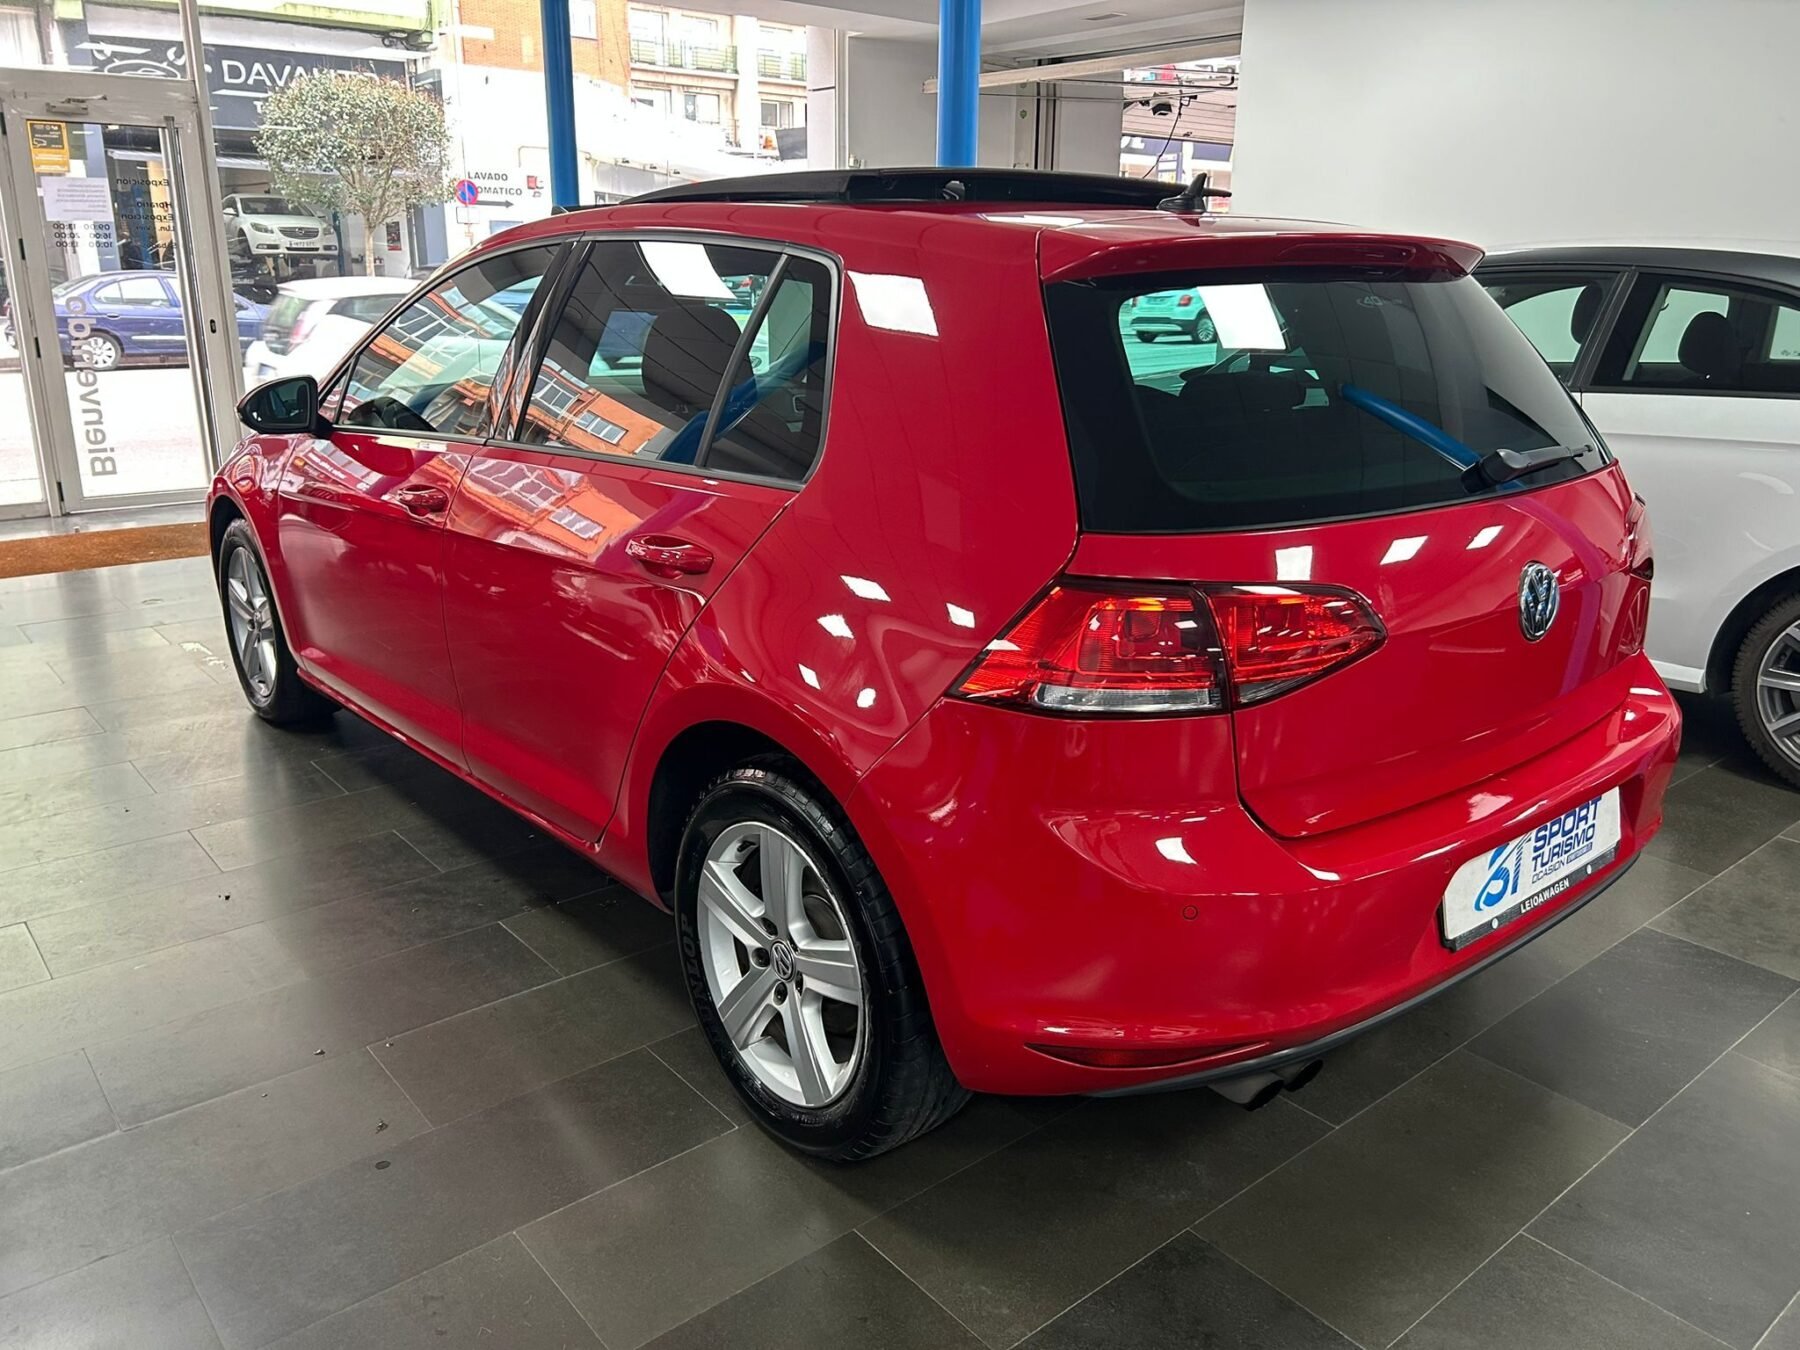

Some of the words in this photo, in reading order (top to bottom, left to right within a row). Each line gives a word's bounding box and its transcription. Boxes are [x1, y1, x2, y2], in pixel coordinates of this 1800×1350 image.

[467, 172, 508, 181] LAVADO
[477, 186, 523, 196] OMATICO
[1533, 795, 1602, 853] SPORT
[1532, 823, 1595, 872] TURISMO
[1520, 878, 1570, 913] LEIOAWAGEN
